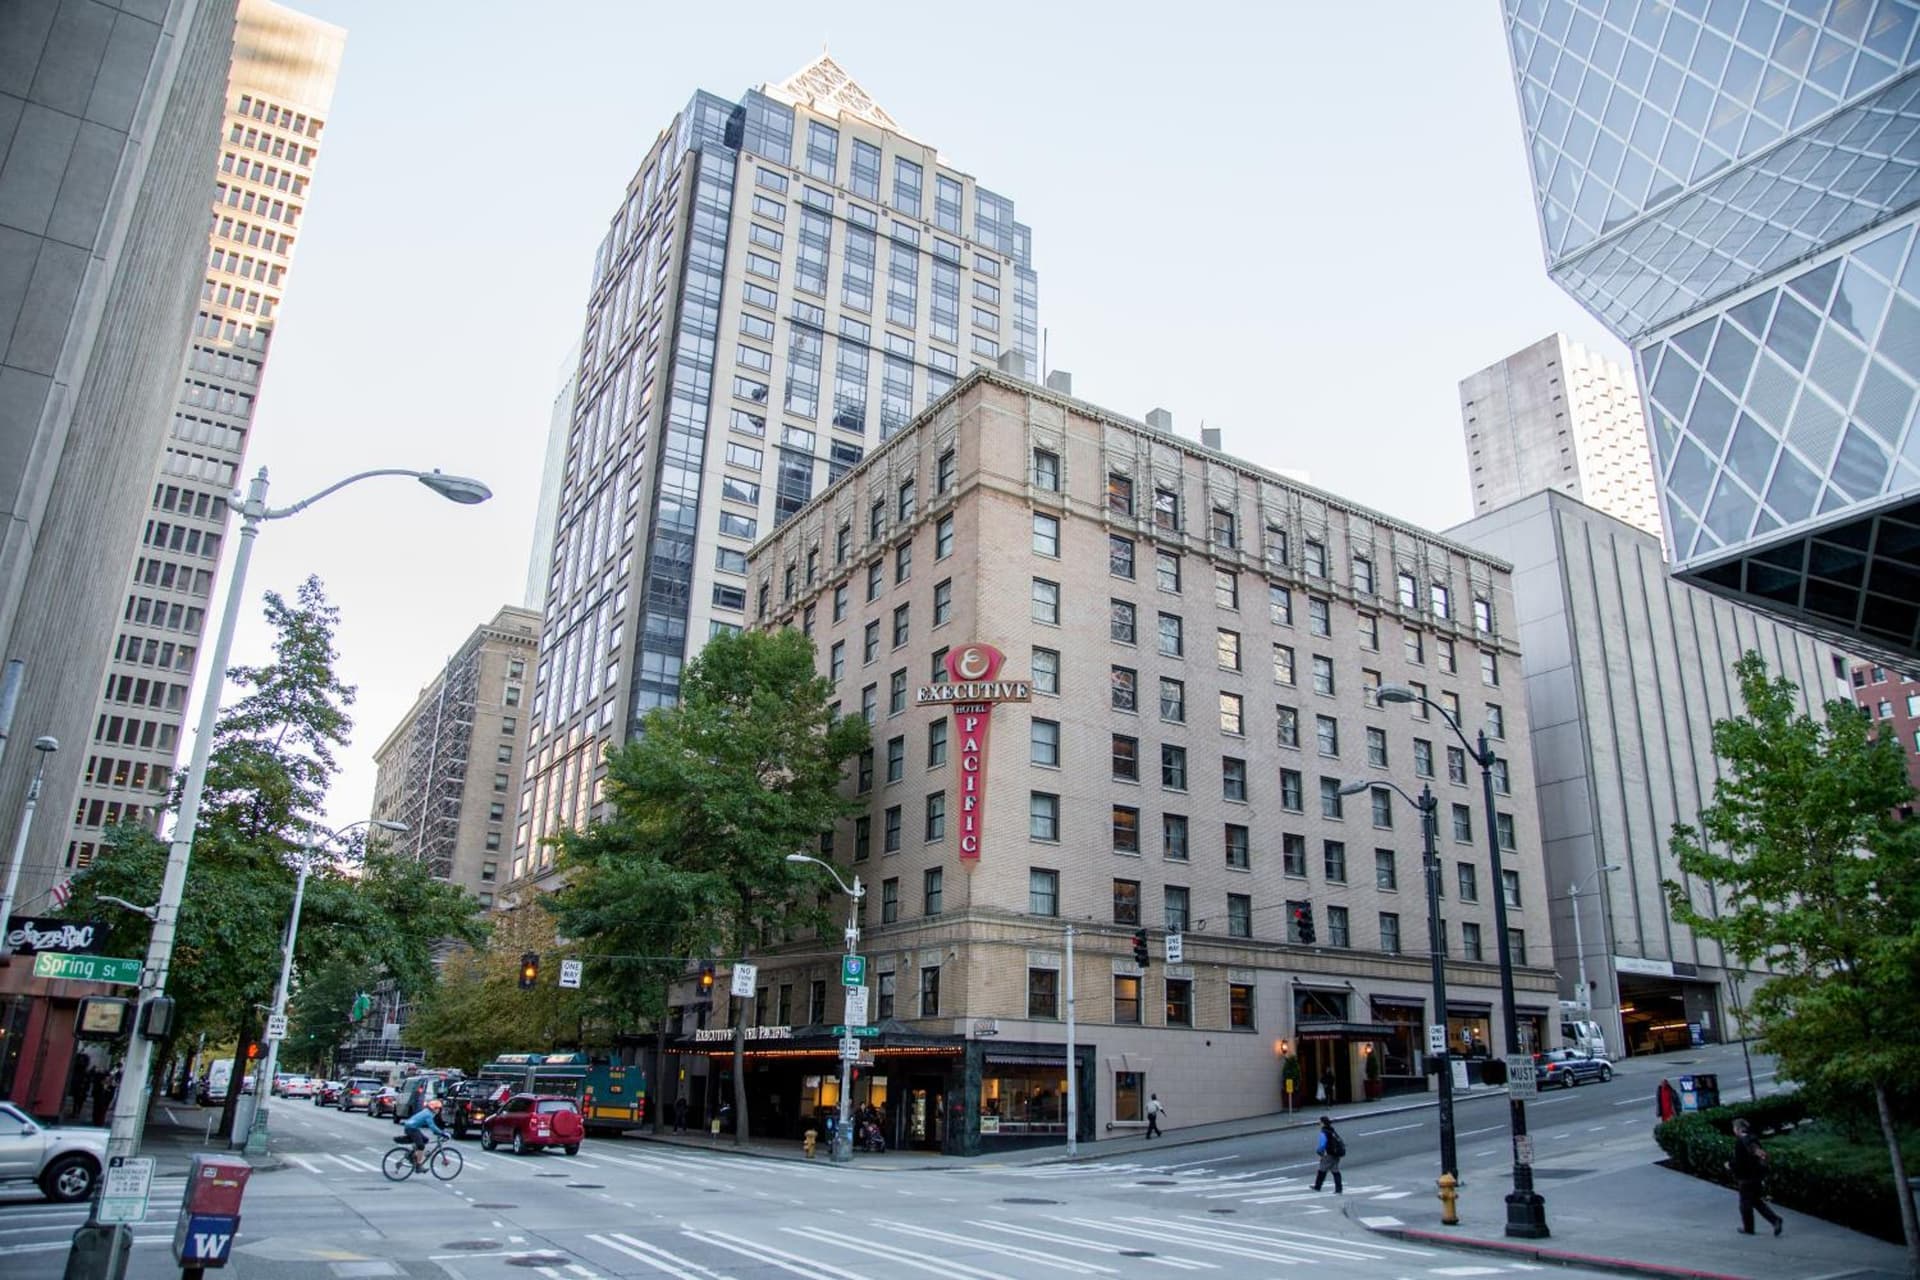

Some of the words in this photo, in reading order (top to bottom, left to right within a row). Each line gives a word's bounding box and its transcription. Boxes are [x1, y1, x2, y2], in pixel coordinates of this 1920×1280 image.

[917, 683, 1028, 702] EXECUTIVE
[955, 704, 988, 714] HOTEL
[962, 717, 980, 852] PACIFIC
[40, 954, 95, 979] Spring
[102, 964, 117, 977] St
[564, 962, 579, 970] ONE
[740, 967, 751, 975] NO
[563, 970, 578, 978] WAY
[696, 1029, 734, 1041] EXECUTIVE
[1511, 1067, 1534, 1081] MUST
[1682, 1081, 1693, 1090] W
[194, 1233, 230, 1258] W
